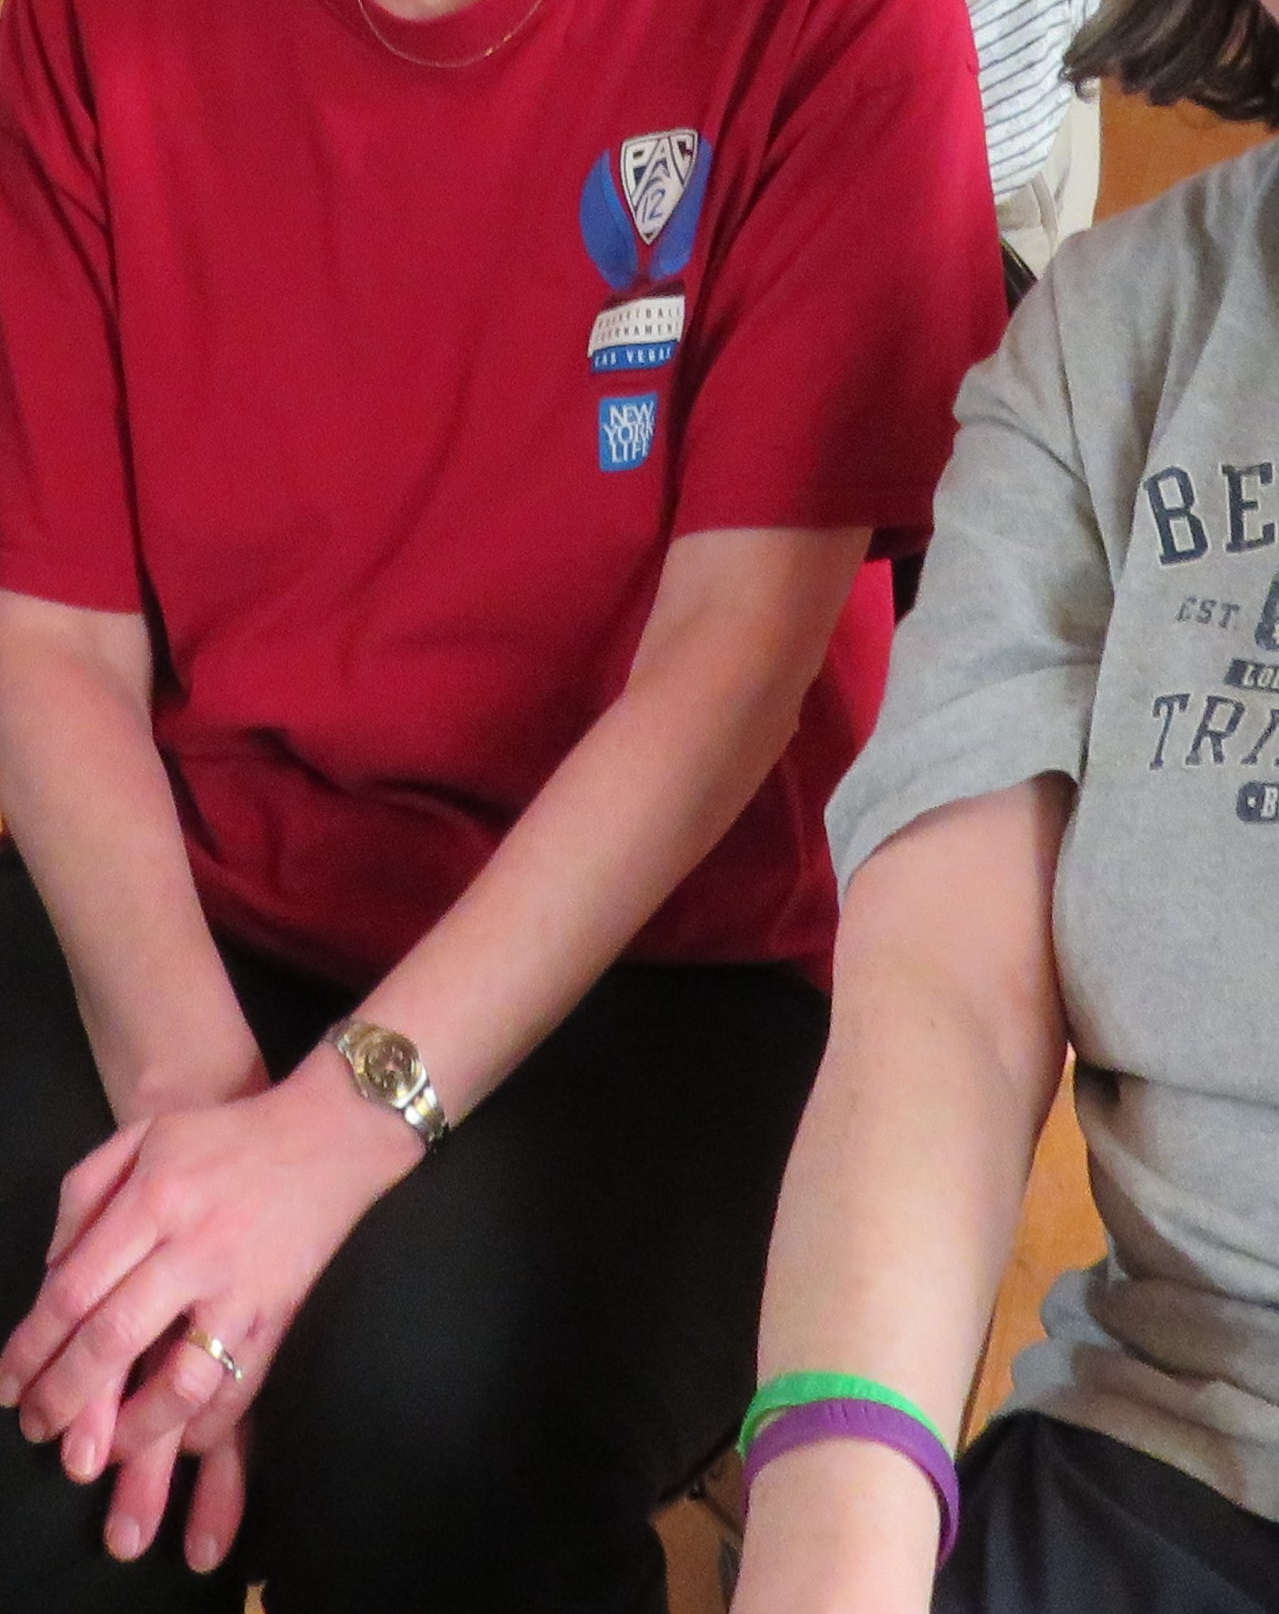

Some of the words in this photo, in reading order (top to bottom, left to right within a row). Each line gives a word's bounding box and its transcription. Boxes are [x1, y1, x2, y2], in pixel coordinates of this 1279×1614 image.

[642, 187, 666, 224] 12
[609, 400, 654, 427] NEW
[601, 420, 654, 445] YORK
